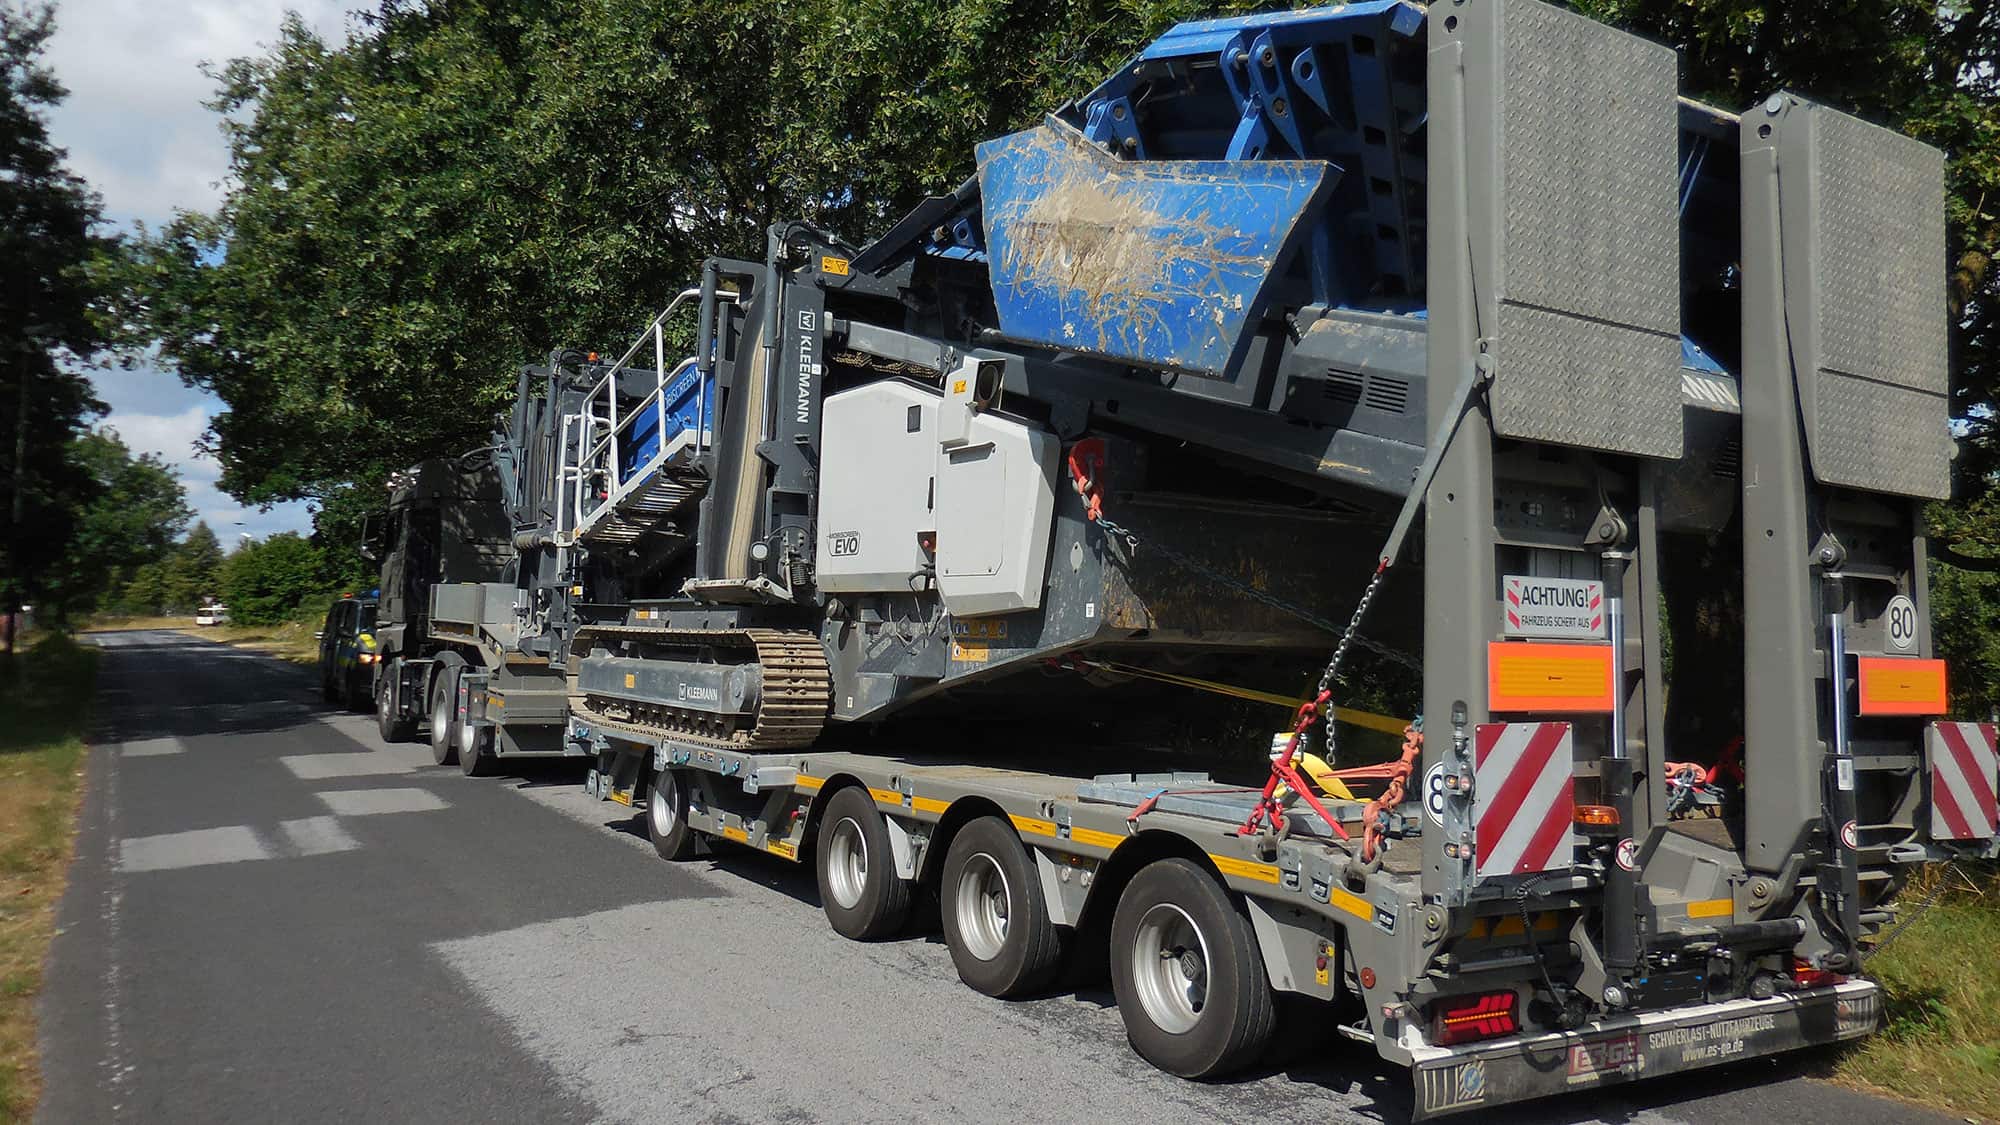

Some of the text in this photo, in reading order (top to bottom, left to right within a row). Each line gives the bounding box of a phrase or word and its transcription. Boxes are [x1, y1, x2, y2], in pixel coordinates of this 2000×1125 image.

[797, 335, 812, 423] KLEEMANN
[835, 538, 857, 554] EVO
[1521, 586, 1589, 608] ACHTUNG!
[1521, 615, 1590, 629] FAHRZEUG SCHERT AUS
[1891, 606, 1914, 639] 80
[686, 686, 718, 700] KLEEMANN
[1649, 1013, 1776, 1050] SCHWERLAST-NUTZFAHRZEUGE
[1682, 1038, 1744, 1063] www.es-ge.de
